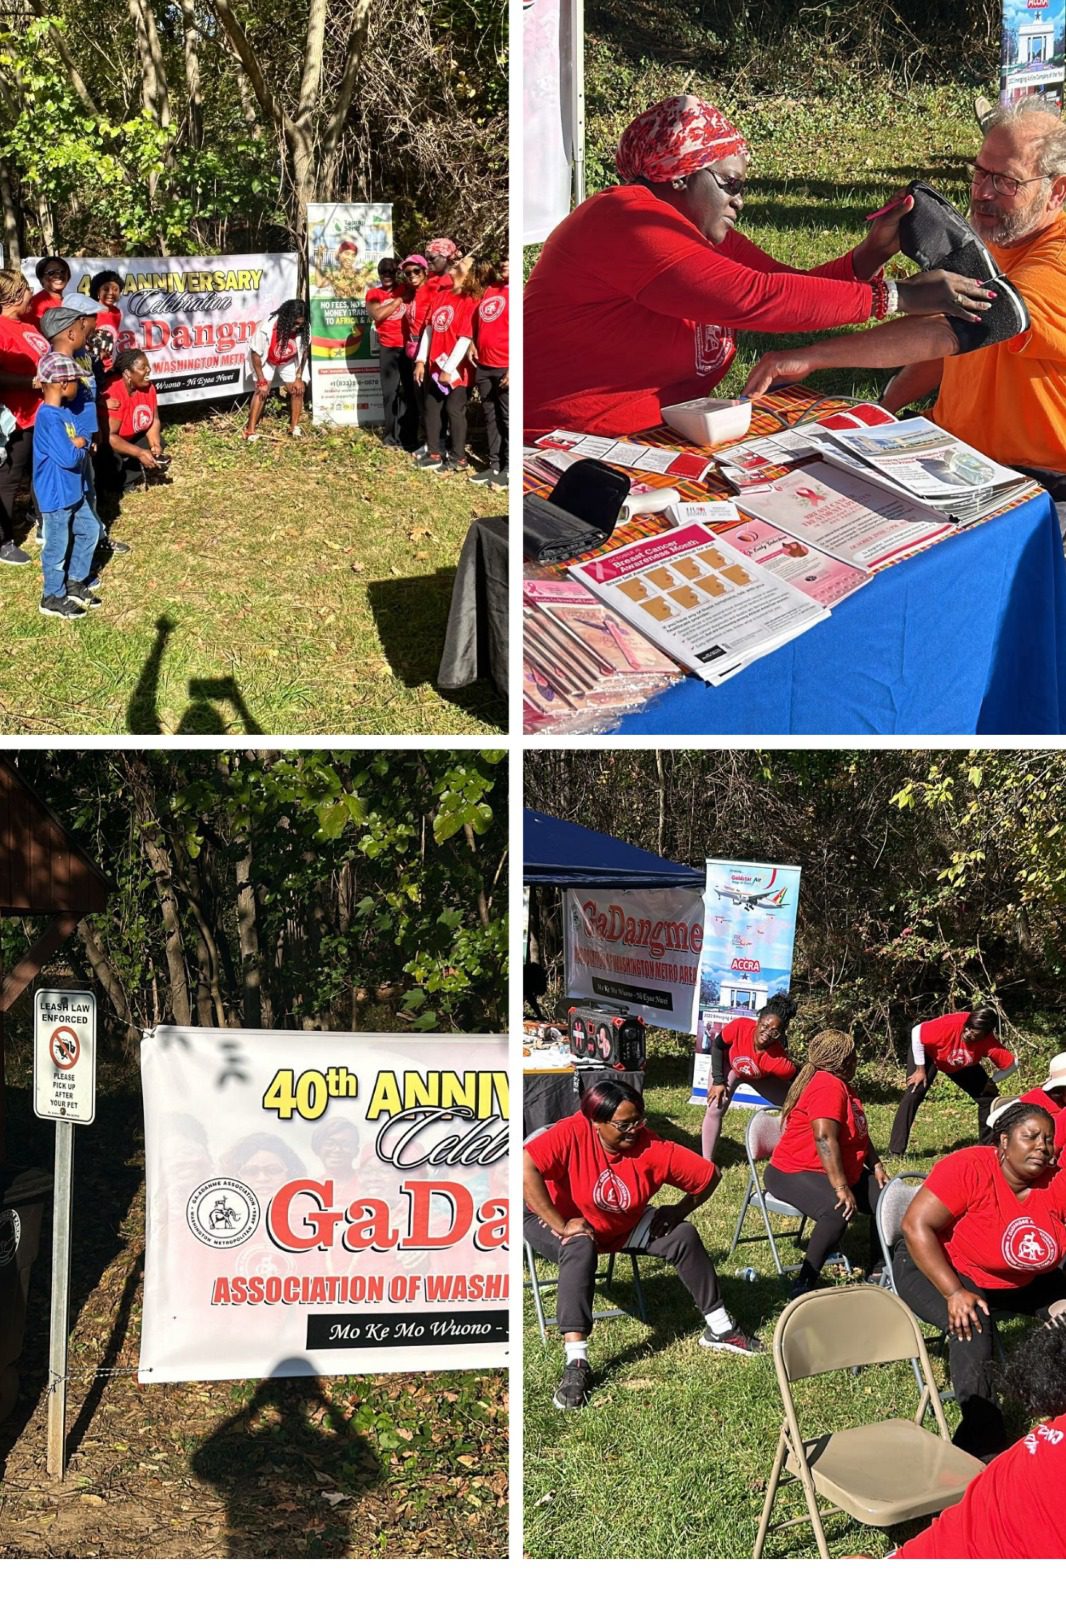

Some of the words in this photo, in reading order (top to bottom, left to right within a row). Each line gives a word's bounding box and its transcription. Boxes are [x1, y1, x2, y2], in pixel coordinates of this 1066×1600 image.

[123, 270, 263, 295] ANNIVERSARY
[127, 288, 233, 317] Celebration
[320, 301, 330, 309] NO
[331, 300, 350, 309] FEES,
[325, 309, 347, 317] MONEY
[326, 317, 335, 325] TO
[152, 358, 218, 374] WASHINGTON
[219, 353, 246, 365] METR
[187, 378, 198, 387] Ni
[612, 552, 644, 568] Breast
[644, 540, 678, 555] Cancer
[619, 549, 670, 573] Awareness
[669, 539, 700, 552] Month
[582, 900, 704, 958] GaDangme
[655, 960, 678, 982] METRO
[731, 959, 760, 971] ACCRA
[40, 1003, 68, 1011] LEASH
[71, 1004, 90, 1013] LAW
[42, 1013, 88, 1024] ENFORCED
[52, 1081, 66, 1089] PICK
[67, 1082, 76, 1090] UP
[53, 1072, 75, 1081] PLEASE
[50, 1099, 65, 1108] YOUR
[67, 1101, 78, 1109] PET
[55, 1091, 73, 1099] AFTER
[262, 1067, 359, 1121] 40th
[223, 1181, 256, 1206] ASSOCIATION
[190, 1211, 211, 1242] WASHINGTON
[213, 1226, 252, 1245] METROPOLITAN
[211, 1274, 385, 1306] ASSOCIATION
[388, 1274, 421, 1305] OF
[328, 1323, 361, 1341] Mo
[365, 1321, 390, 1342] Ke
[392, 1321, 425, 1338] Mo
[428, 1320, 492, 1336] Wuono
